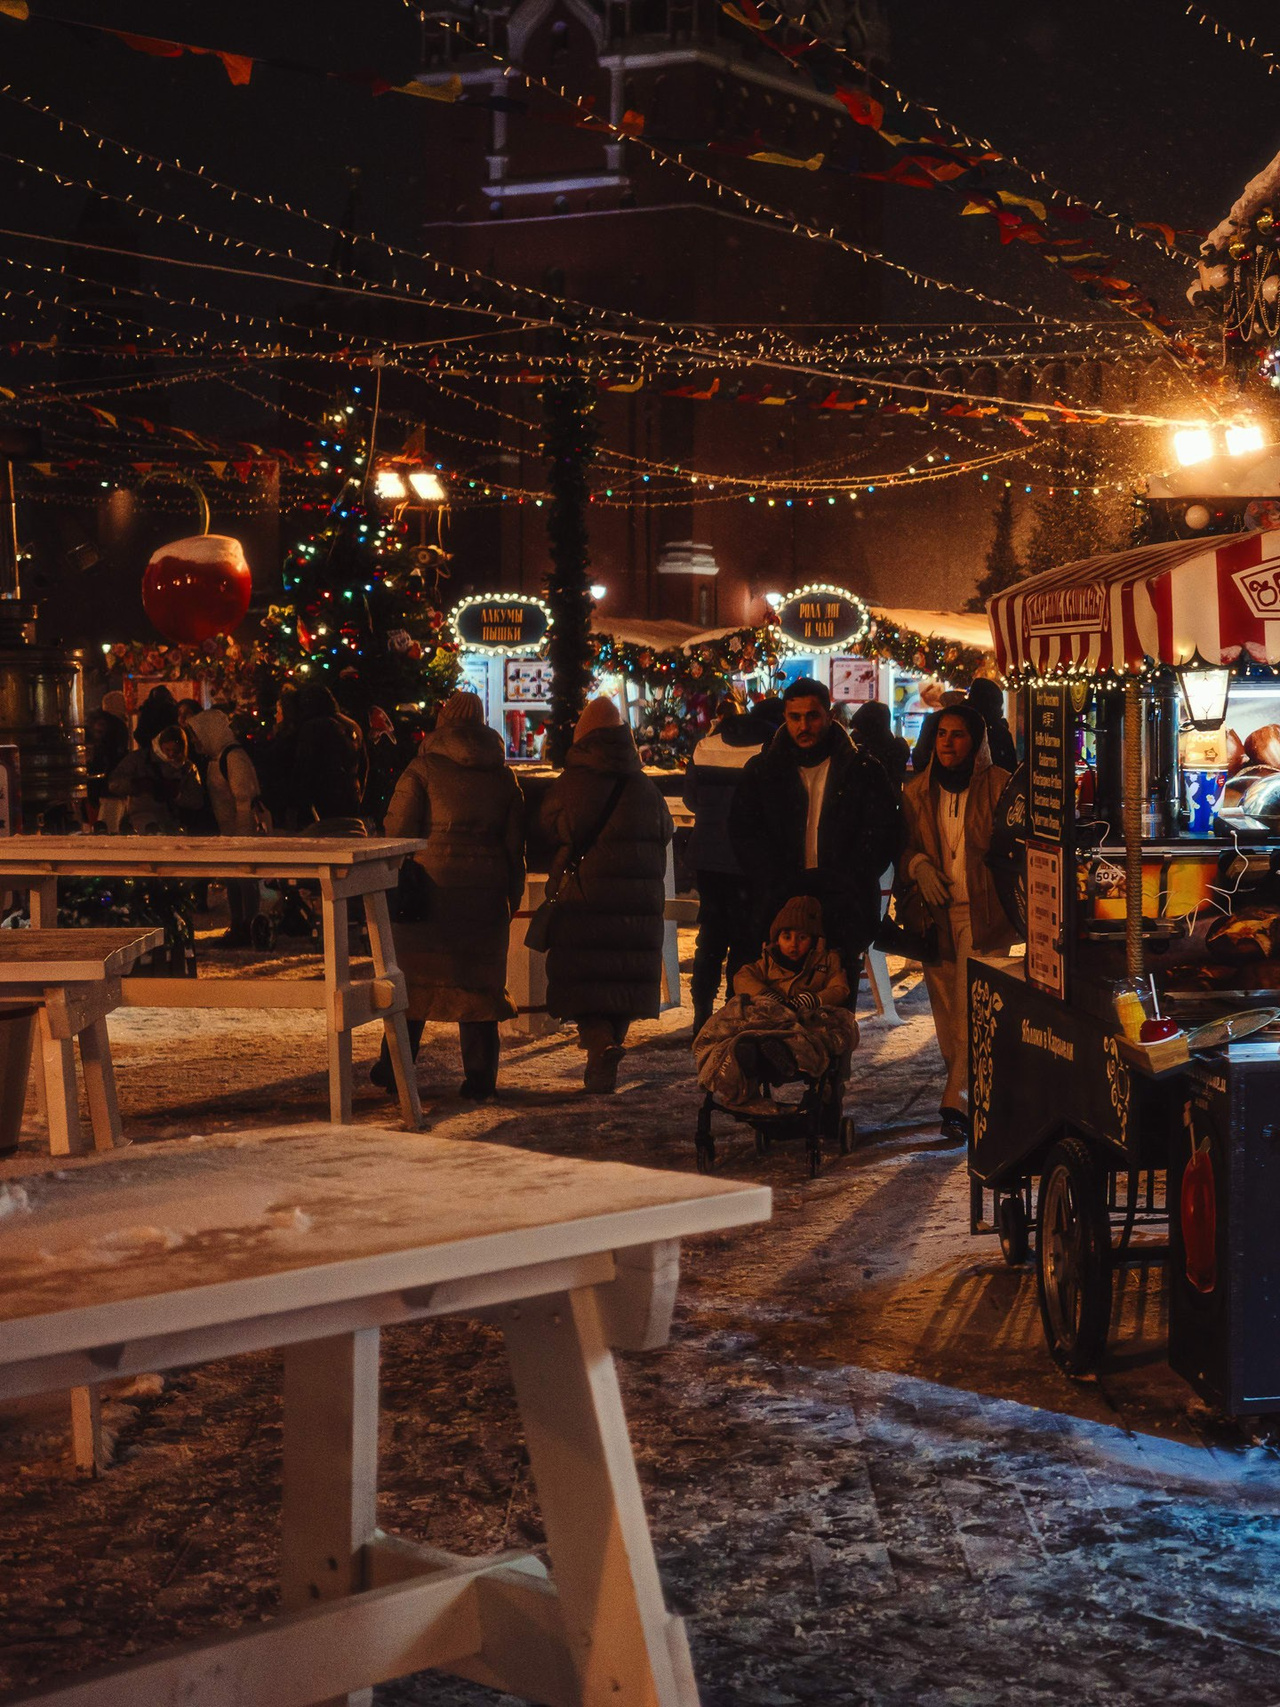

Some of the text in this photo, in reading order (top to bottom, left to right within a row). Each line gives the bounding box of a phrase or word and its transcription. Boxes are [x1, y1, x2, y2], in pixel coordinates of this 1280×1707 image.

[483, 626, 521, 641] ПЫШКИ
[804, 620, 834, 638] И ЧАЙ
